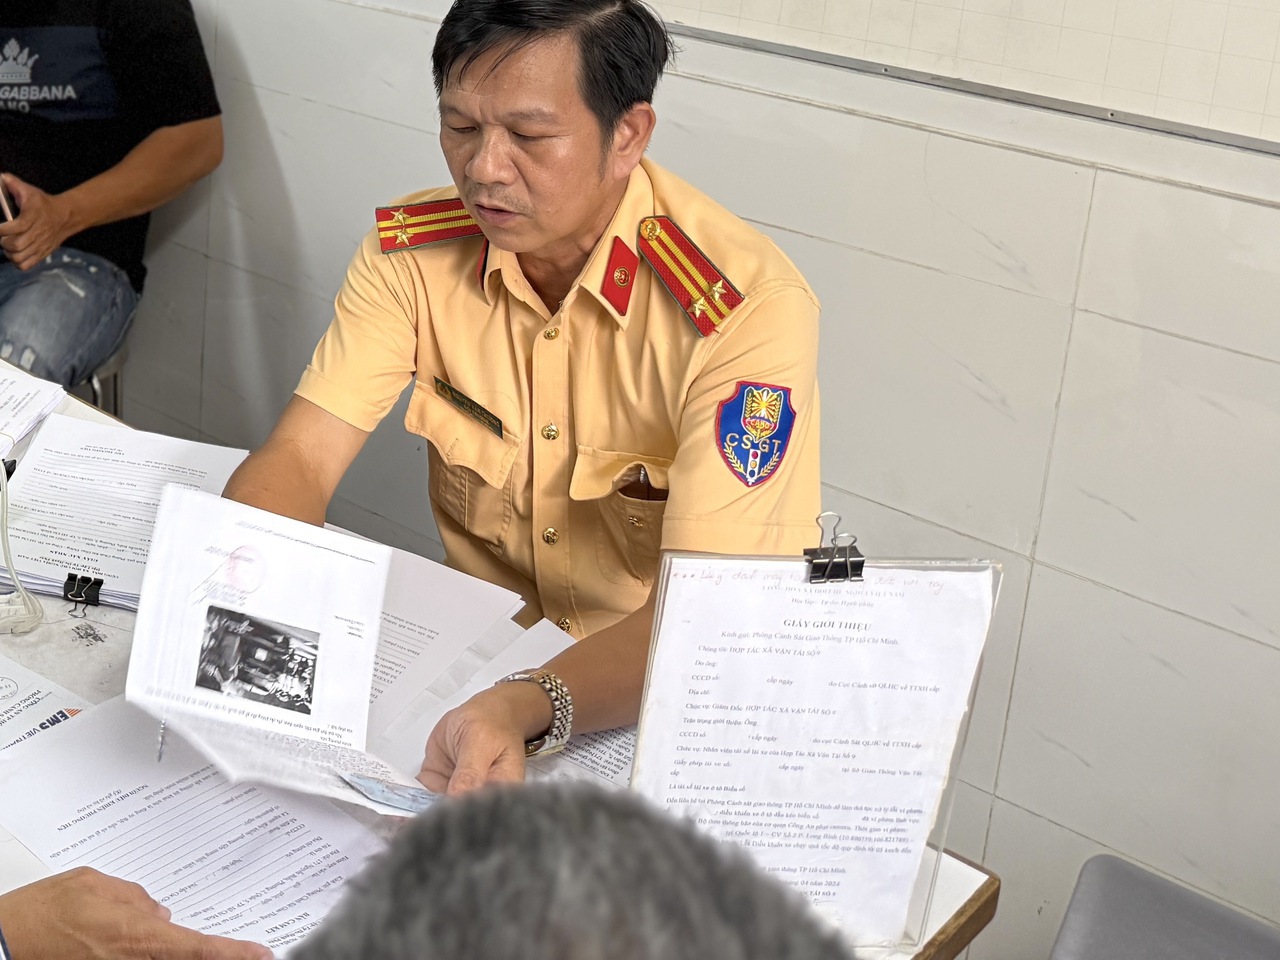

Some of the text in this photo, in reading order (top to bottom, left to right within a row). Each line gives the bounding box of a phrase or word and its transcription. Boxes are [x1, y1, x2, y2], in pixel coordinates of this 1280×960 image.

[725, 432, 782, 453] CSGT
[783, 616, 872, 632] GIẤY GIỚI THIỆU
